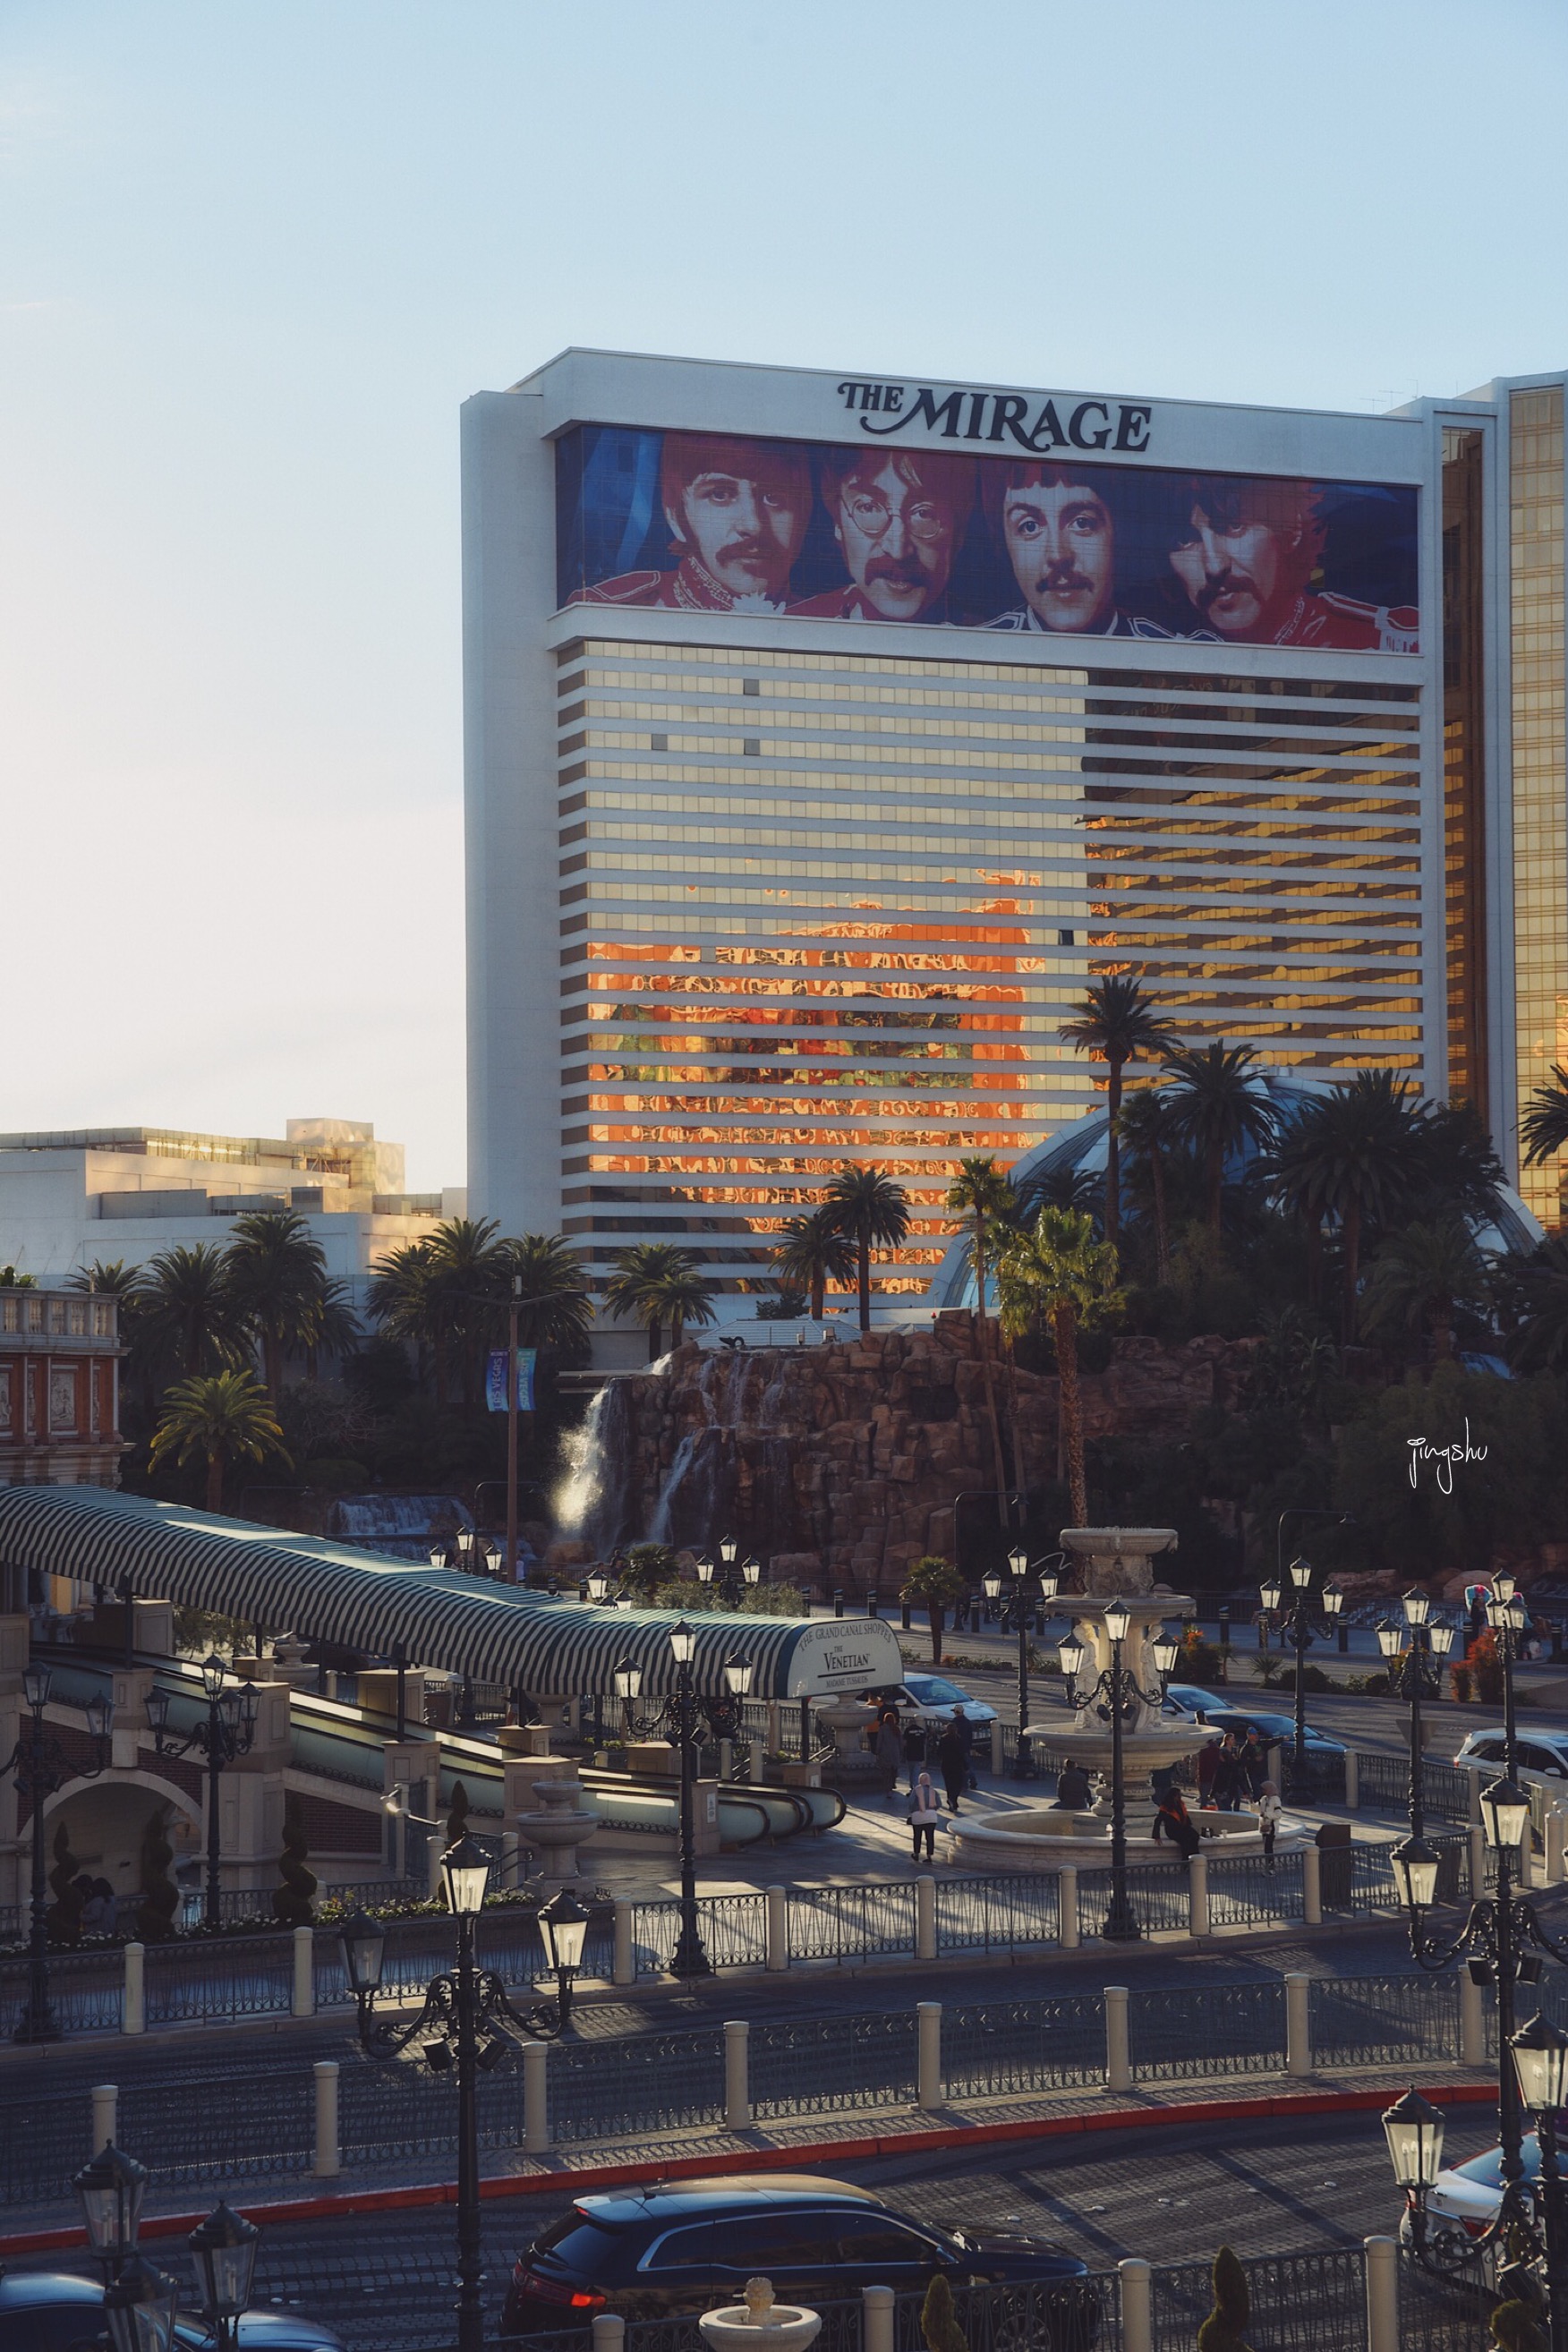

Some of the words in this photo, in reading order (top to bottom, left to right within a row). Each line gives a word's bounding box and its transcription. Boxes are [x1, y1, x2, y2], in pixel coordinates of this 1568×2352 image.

[837, 381, 904, 413] THE
[860, 388, 1152, 453] MIRAGE
[491, 1357, 503, 1389] VEGAS
[494, 1391, 503, 1410] LAS
[798, 1632, 814, 1653] THE
[814, 1626, 839, 1640] GRAND
[840, 1623, 863, 1638] CANAL
[864, 1623, 892, 1643] SHOPPES
[834, 1645, 843, 1653] THE
[823, 1652, 870, 1671] VENETIAN
